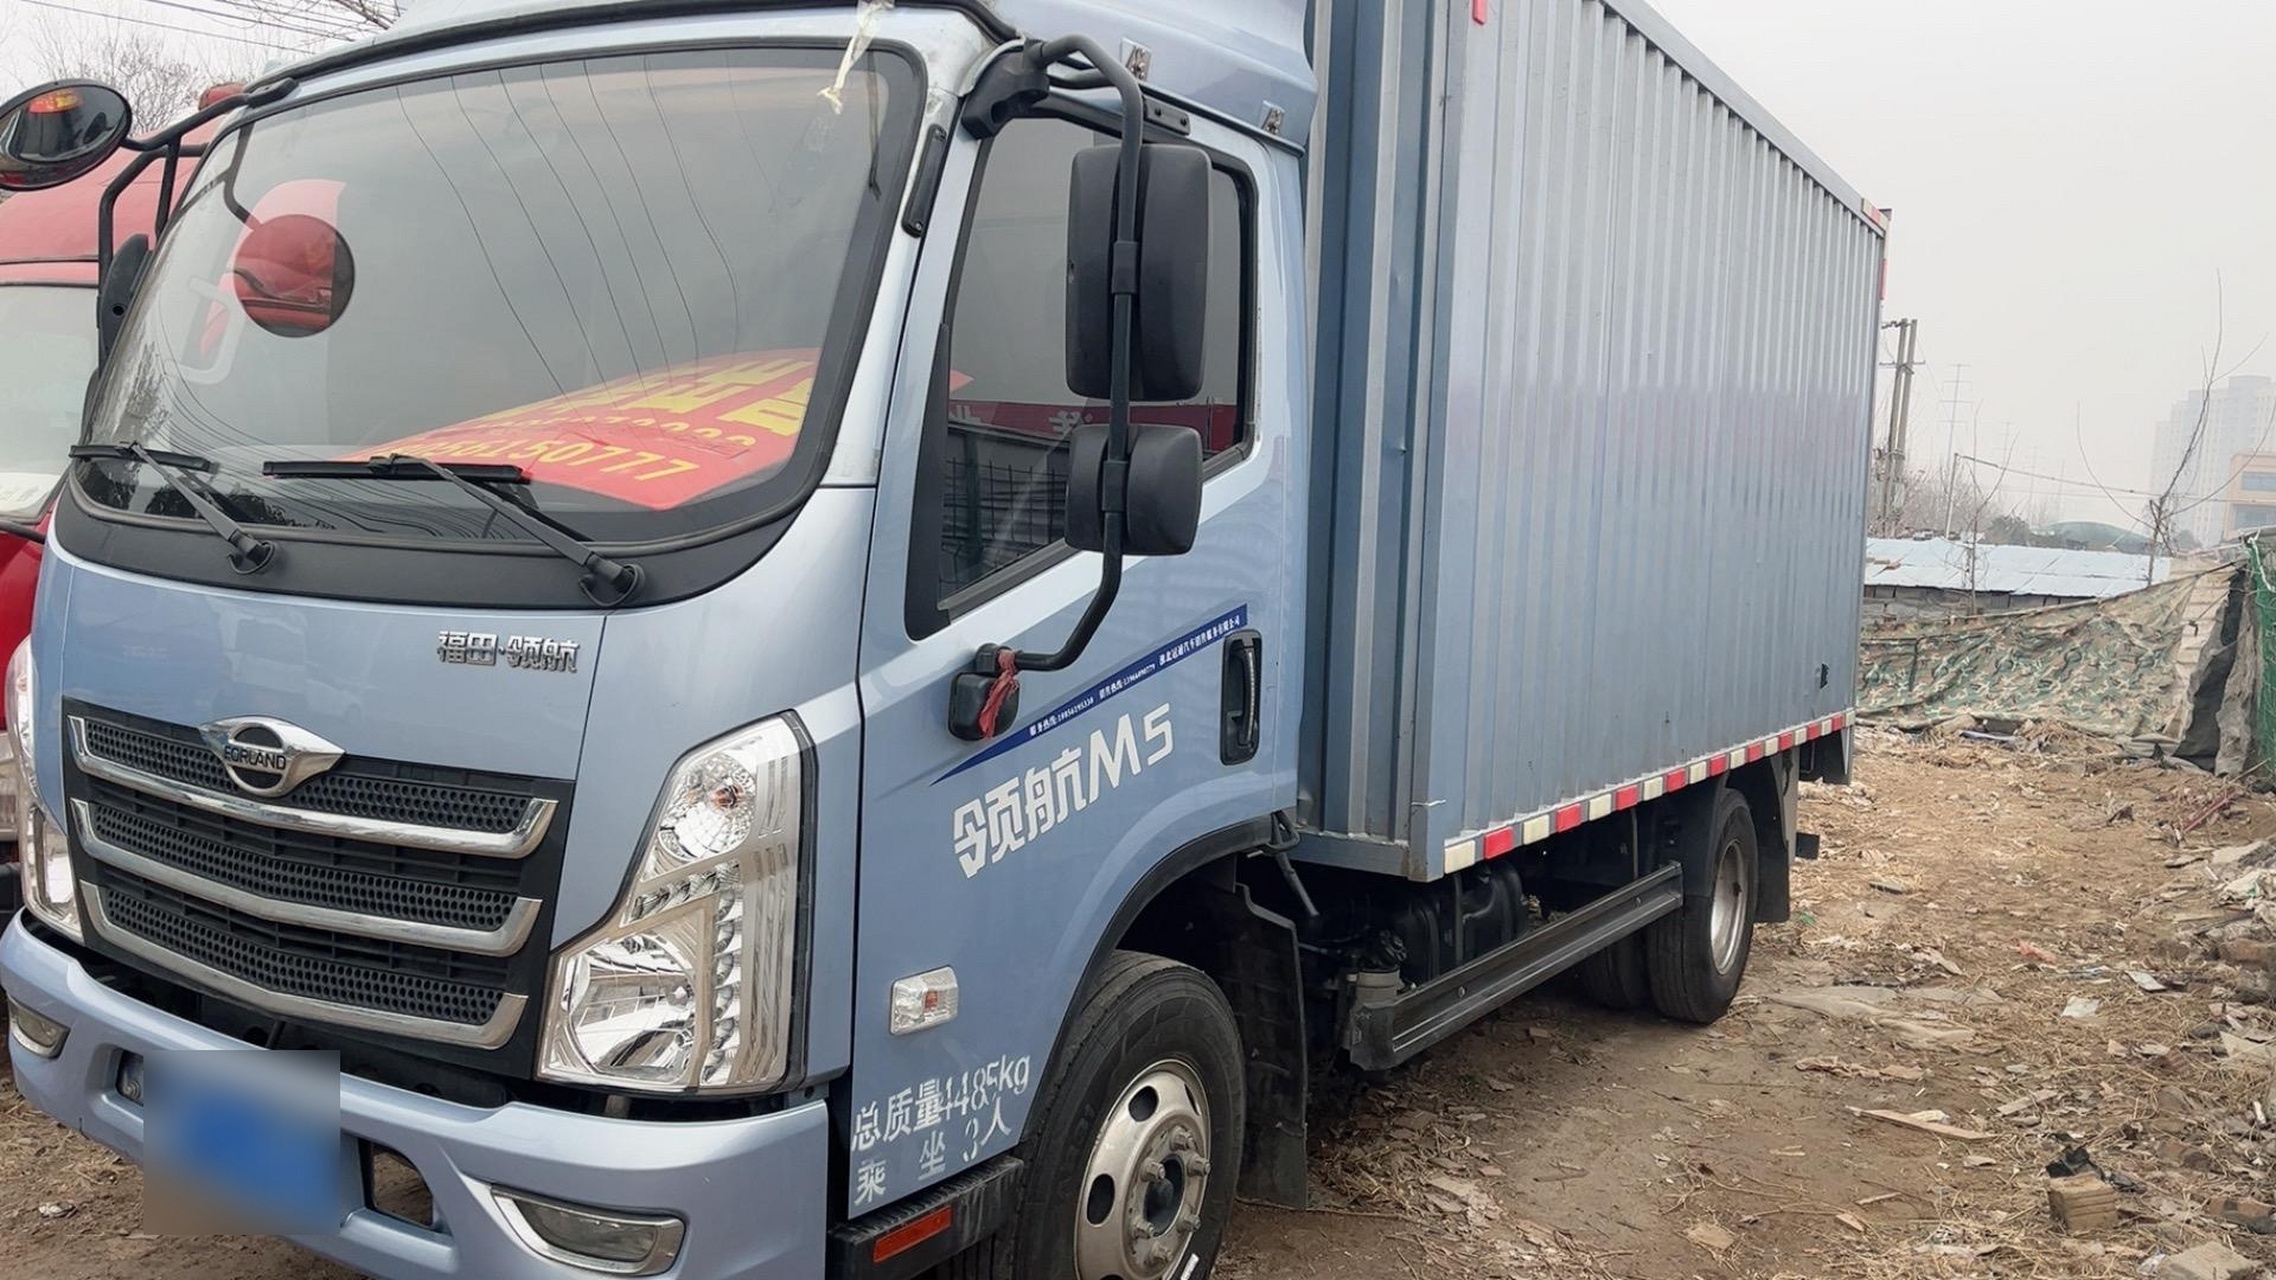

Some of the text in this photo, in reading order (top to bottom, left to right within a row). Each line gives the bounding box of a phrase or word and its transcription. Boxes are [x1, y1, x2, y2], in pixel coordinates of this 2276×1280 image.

[436, 631, 581, 673] 福田·领航
[953, 702, 1174, 879] 领航M5
